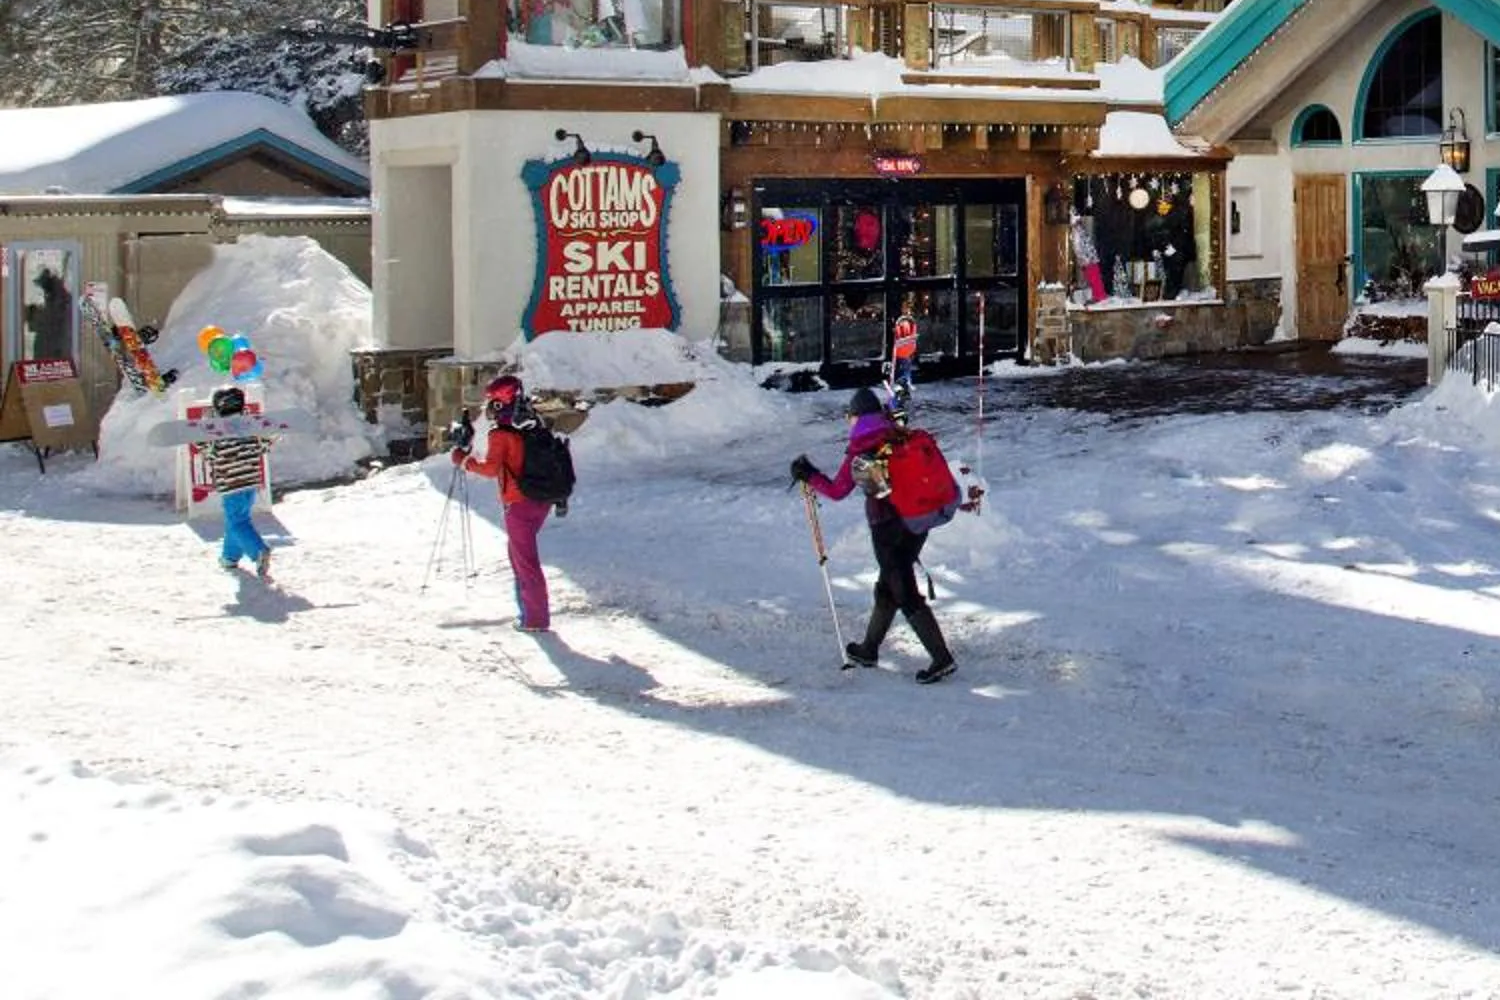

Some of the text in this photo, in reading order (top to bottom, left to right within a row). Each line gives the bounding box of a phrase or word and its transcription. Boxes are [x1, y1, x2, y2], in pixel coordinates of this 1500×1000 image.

[550, 166, 657, 230] COTTAMS
[570, 211, 640, 229] SKI SHOP
[563, 240, 647, 274] SKI
[549, 271, 660, 301] RENTALS
[560, 299, 646, 317] APPAREL
[567, 315, 641, 332] TUNING
